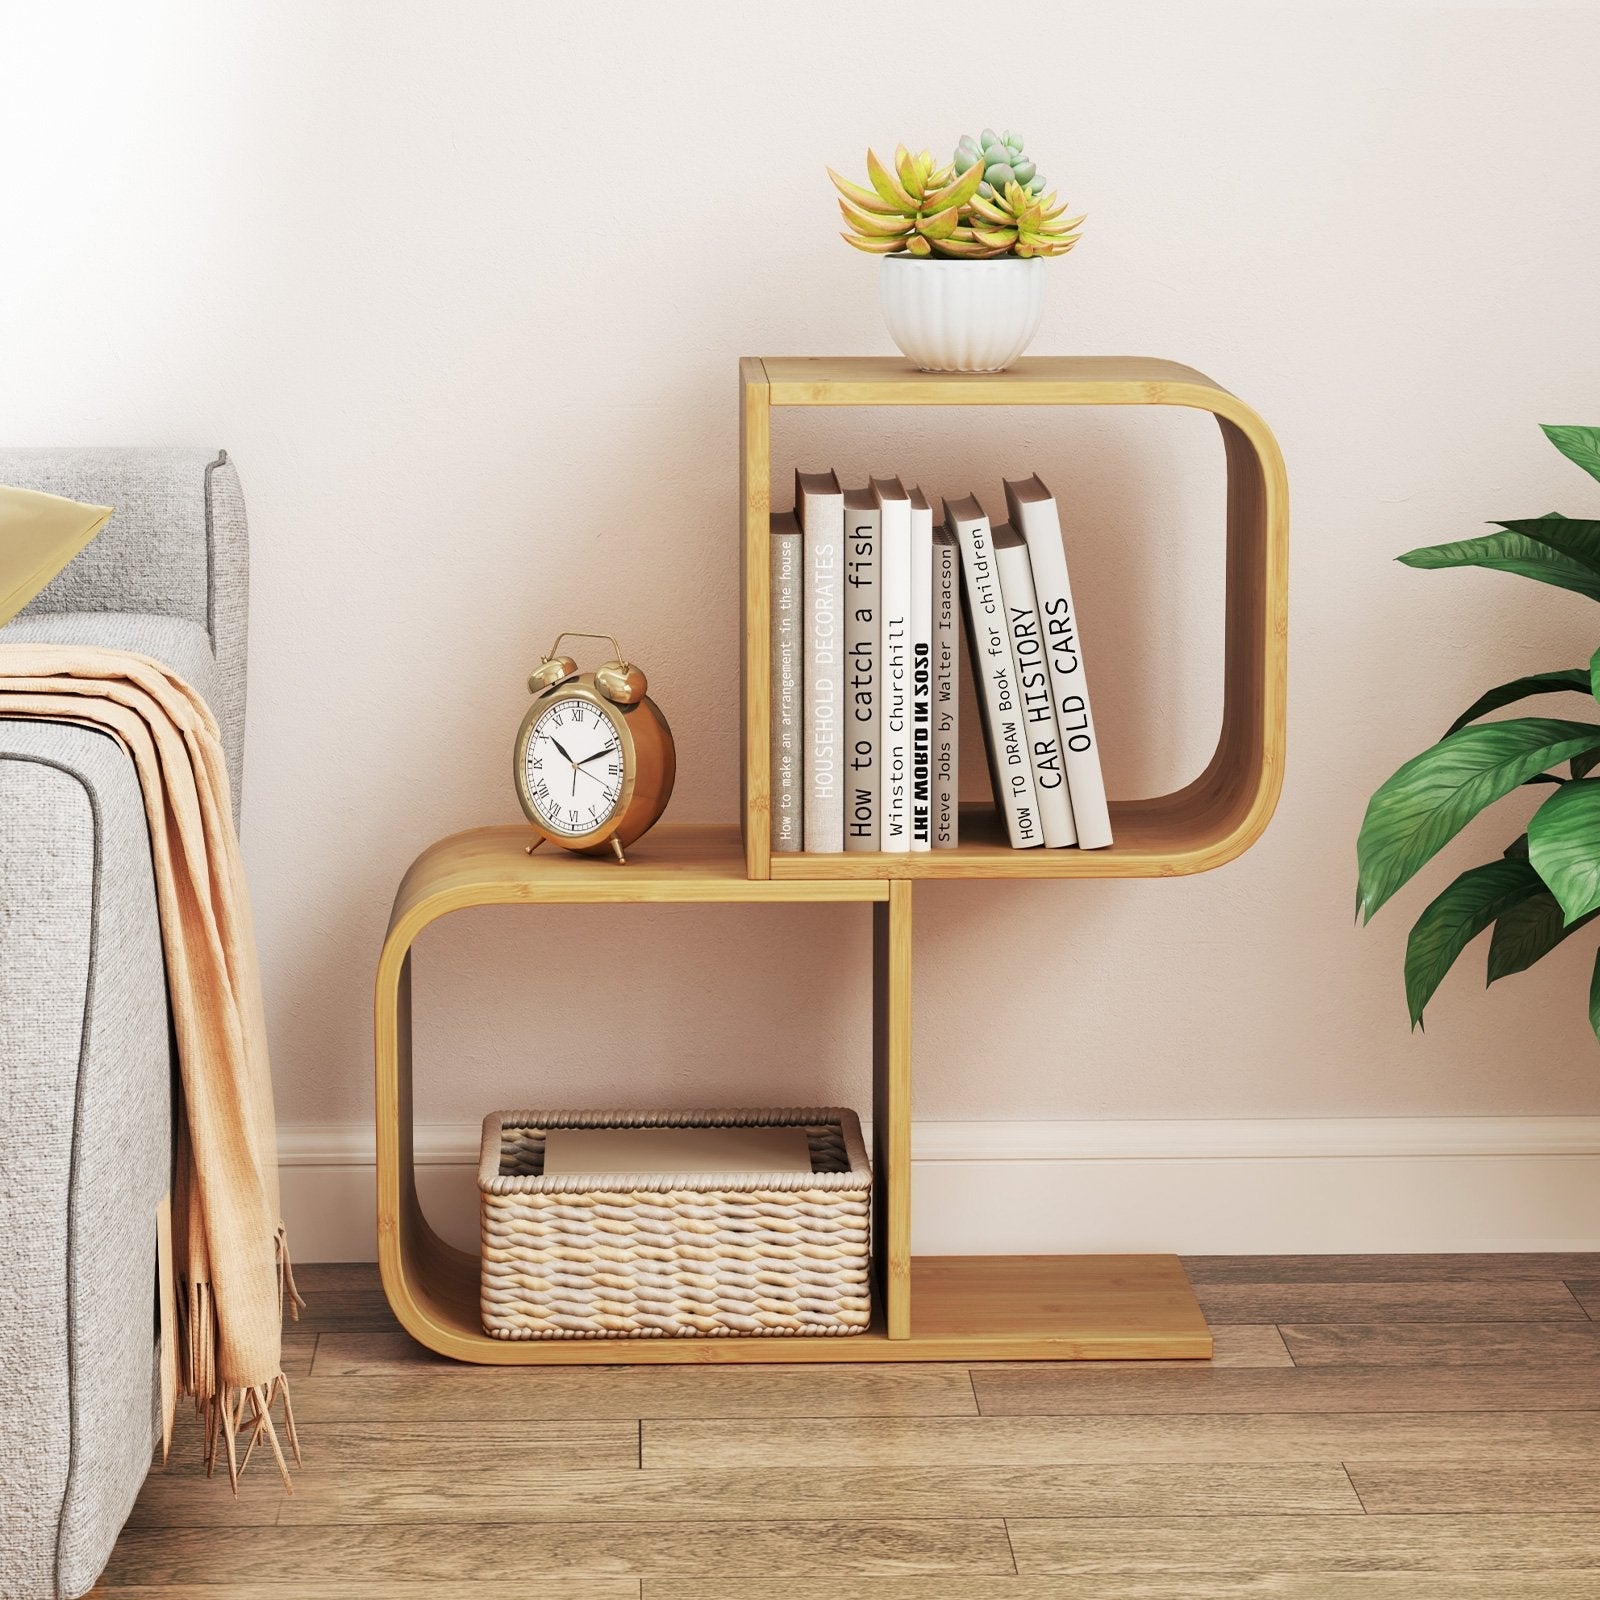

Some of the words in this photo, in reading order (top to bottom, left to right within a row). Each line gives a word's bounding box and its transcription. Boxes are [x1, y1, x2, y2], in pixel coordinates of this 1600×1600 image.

[779, 542, 791, 580] house
[849, 525, 872, 589] fish
[969, 528, 996, 614] children
[779, 587, 791, 610] the
[815, 544, 834, 663] DECORATES
[939, 549, 951, 629] Isaacson
[779, 618, 791, 634] in
[855, 608, 872, 622] a
[987, 627, 1003, 657] for
[1045, 598, 1077, 673] CARS
[850, 642, 872, 722] catch
[889, 617, 904, 732] Churchill
[938, 642, 951, 702] Walter
[1011, 606, 1051, 722] HISTORY
[781, 642, 793, 725] arrangement
[994, 668, 1012, 711] Book
[572, 710, 583, 722] XII
[938, 712, 953, 731] by
[1062, 696, 1091, 752] OLD
[605, 739, 614, 748] II
[782, 733, 791, 748] an
[815, 679, 834, 798] HOUSEHOLD
[852, 741, 872, 771] to
[1002, 722, 1021, 765] DRAW
[534, 758, 542, 770] IX
[609, 765, 618, 775] III
[779, 756, 791, 787] make
[938, 743, 950, 781] Jobs
[1034, 739, 1062, 788] CAR
[537, 779, 549, 798] VIII
[781, 794, 791, 808] to
[889, 747, 904, 836] Winston
[1012, 776, 1027, 797] TO
[549, 800, 561, 814] VII
[569, 811, 578, 822] VI
[850, 789, 872, 836] How
[938, 793, 950, 842] Steve
[1017, 808, 1033, 839] HOW
[780, 814, 791, 840] How
